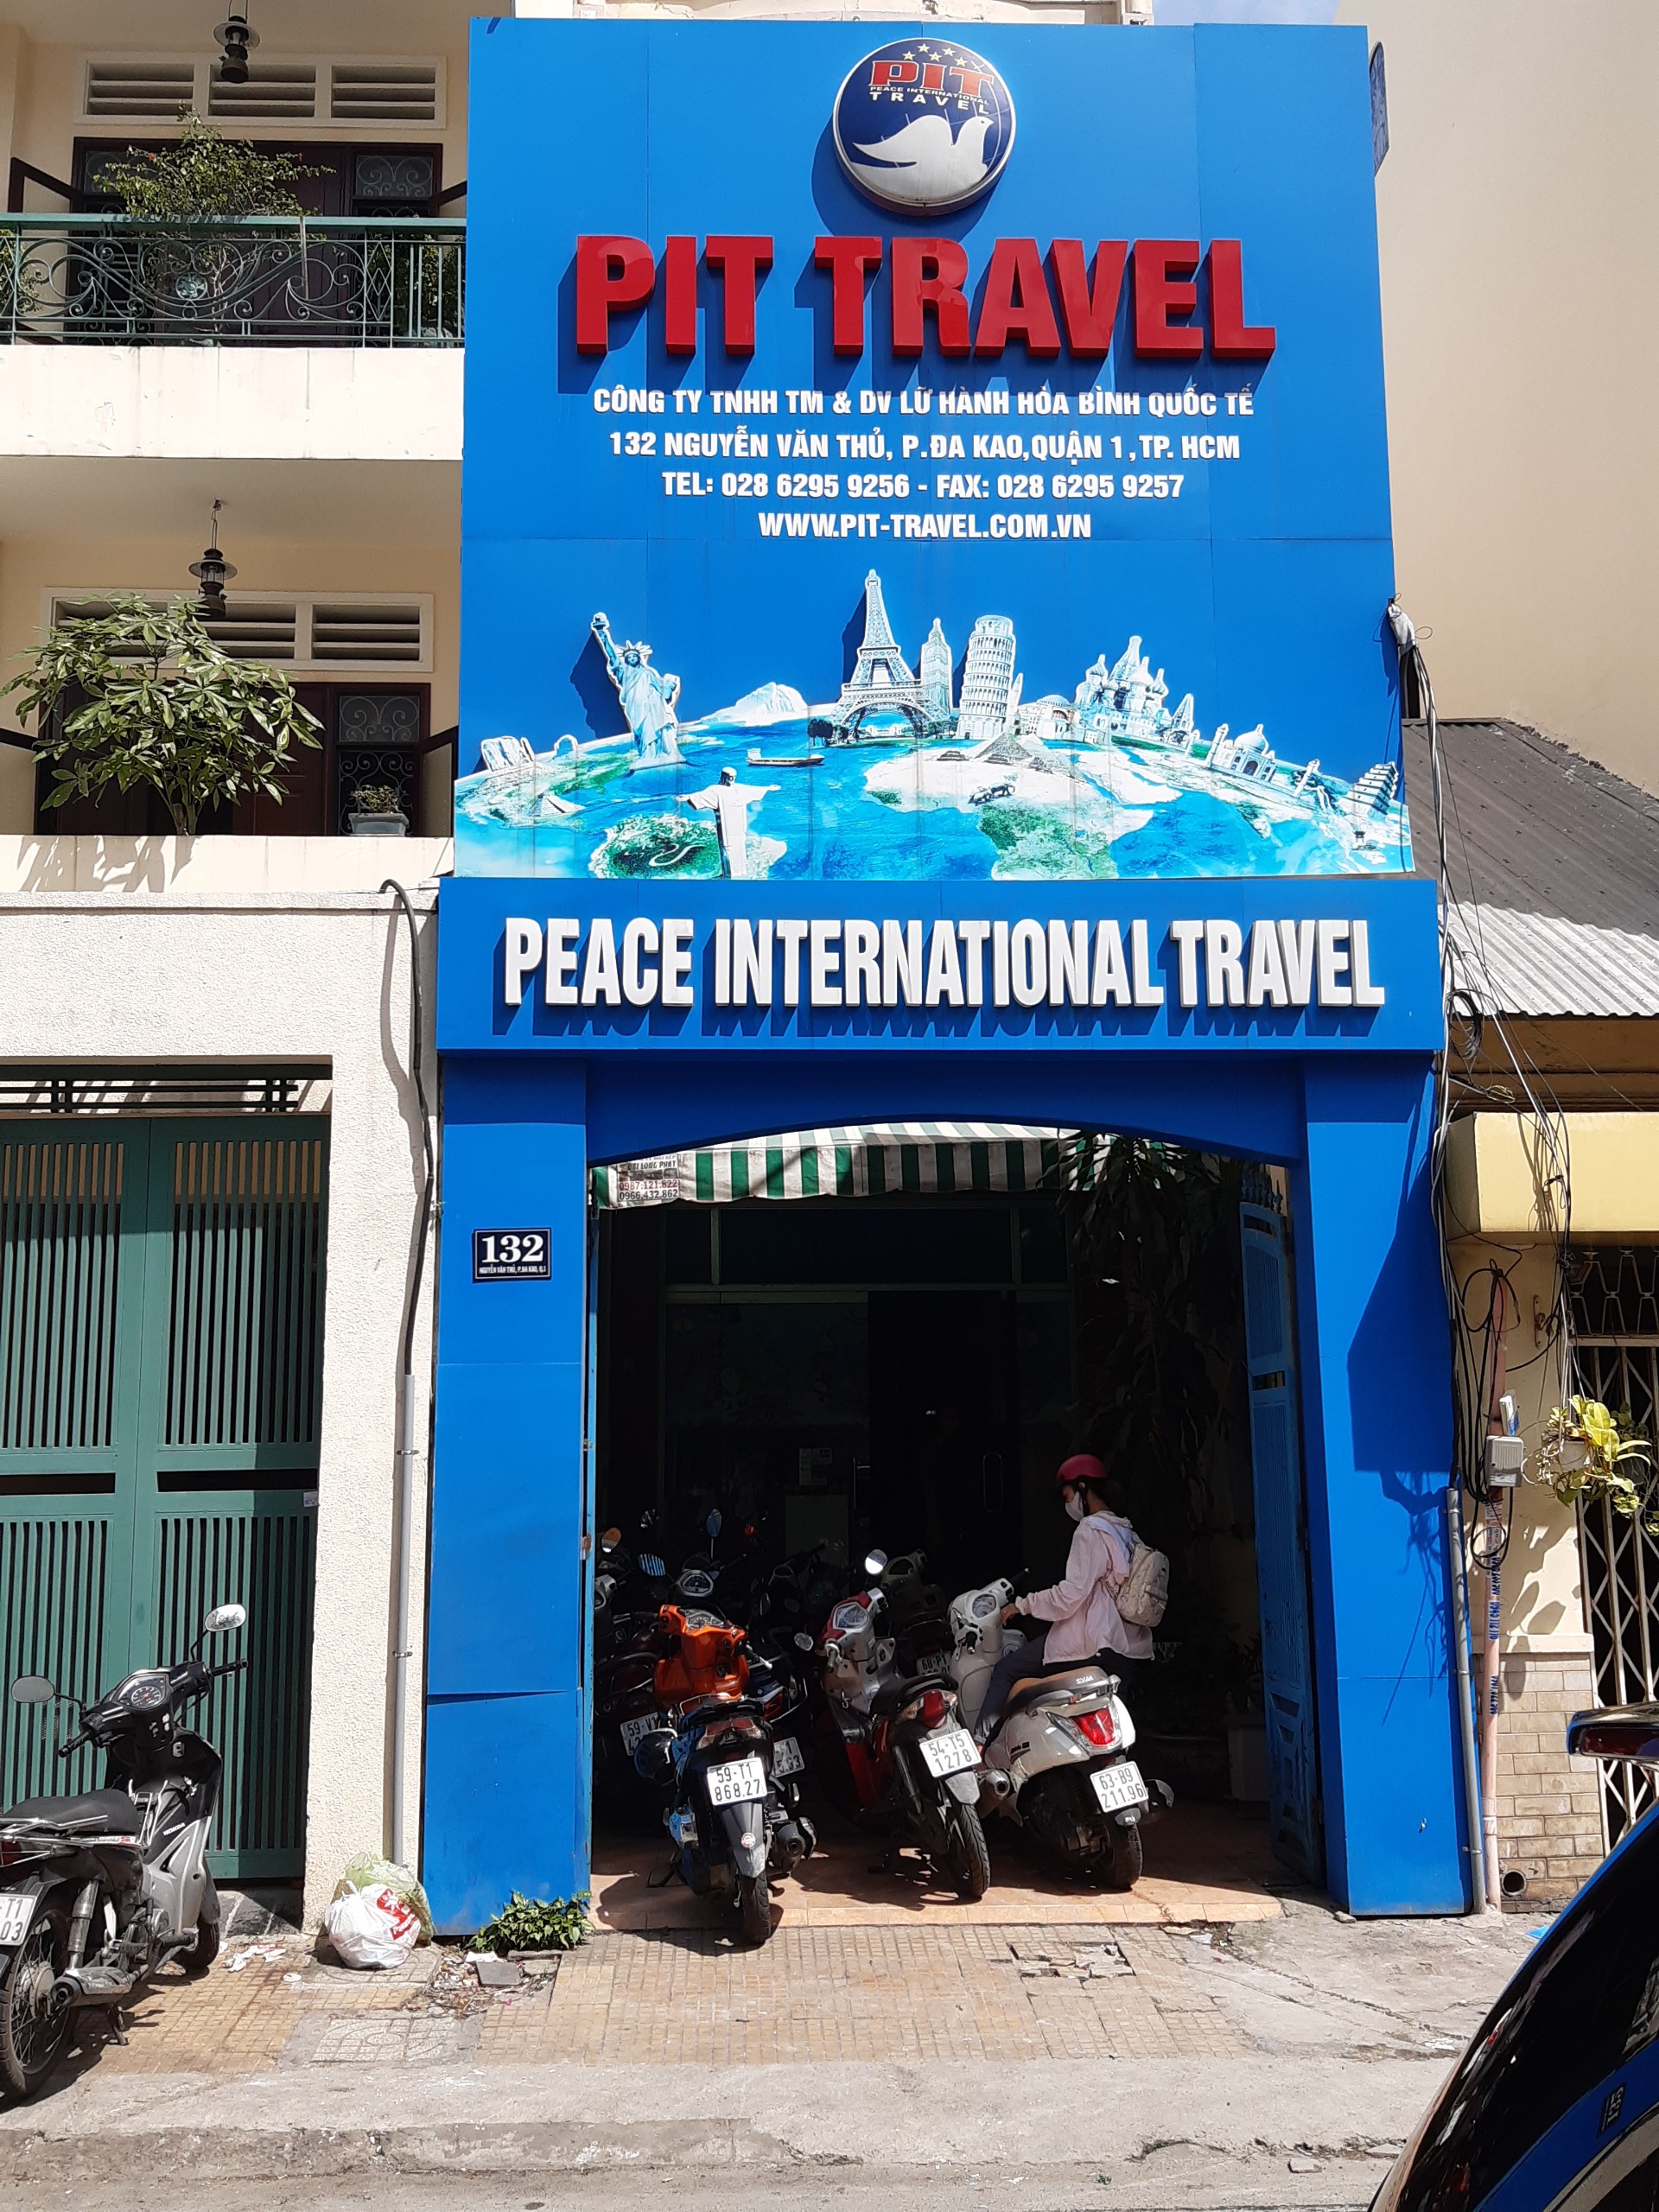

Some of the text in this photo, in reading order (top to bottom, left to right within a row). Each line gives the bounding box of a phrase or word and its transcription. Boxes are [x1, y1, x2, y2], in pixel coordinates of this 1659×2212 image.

[868, 60, 994, 98] PIT
[869, 91, 989, 115] TRAVEL
[906, 87, 989, 105] INTERNATIONAL
[575, 235, 1277, 359] PIT TRAVEL
[594, 383, 1254, 416] CÔNG TY TNHH TM & DV LỮ HÀNH HÒA BÌNH QUỐC TẾ
[610, 432, 657, 456] 132
[664, 426, 768, 458] NGUYỄN
[777, 429, 829, 458] VĂN
[836, 427, 893, 461] THỦ,
[1181, 435, 1240, 460] HCM
[662, 473, 714, 496] TEL:
[721, 473, 768, 498] 028
[777, 474, 839, 498] 6295
[847, 474, 910, 498] 9256
[938, 474, 989, 499] FAX:
[997, 474, 1045, 499] 028
[1052, 474, 1115, 499] 6295
[1122, 474, 1185, 499] 9257
[758, 512, 1091, 538] WWW.PIT-TRAVEL.COM.VN
[505, 918, 1386, 1007] PEACE INTERNATIONAL TRAVEL
[641, 1161, 658, 1170] LONG
[619, 1179, 677, 1191] 0987.121.822
[619, 1189, 678, 1200] 0966.432.862
[481, 1234, 544, 1263] 132
[929, 1734, 965, 1757] 54-T5
[935, 1748, 972, 1772] 1278
[715, 1762, 753, 1783] 59-T1
[1098, 1768, 1134, 1790] 63-B9
[714, 1778, 761, 1802] 868.27
[1101, 1783, 1144, 1809] 211.96
[162, 1822, 186, 1836] HONDA
